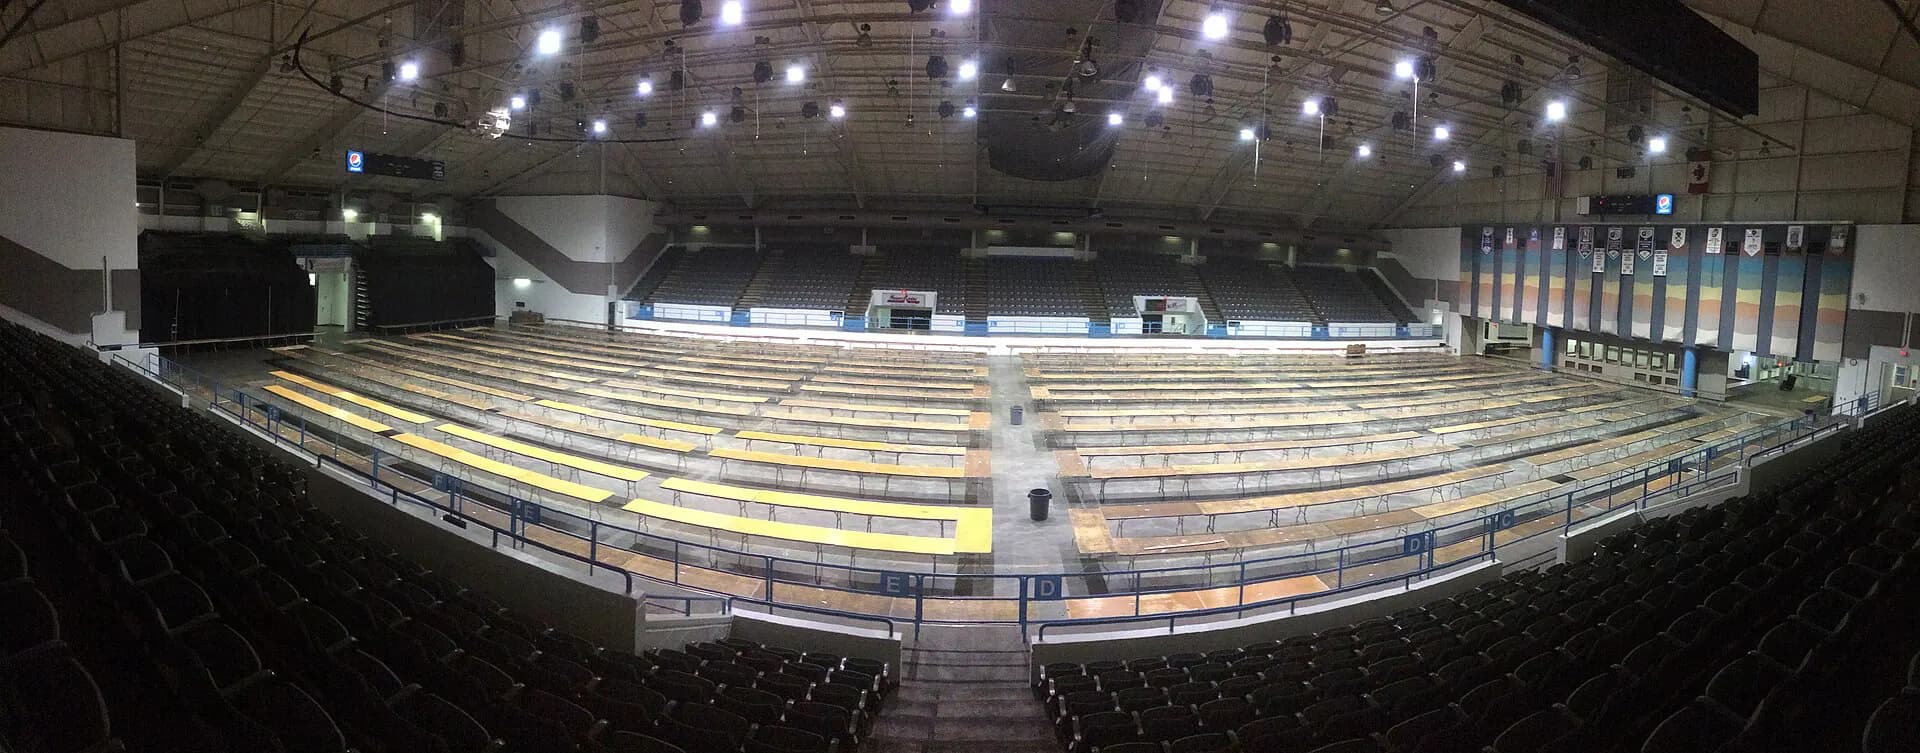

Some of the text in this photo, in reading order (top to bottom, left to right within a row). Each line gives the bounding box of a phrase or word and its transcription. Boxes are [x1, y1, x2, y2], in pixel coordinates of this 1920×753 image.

[525, 504, 533, 518] E
[1502, 513, 1512, 527] C
[1410, 538, 1420, 552] D
[887, 576, 900, 593] E
[1040, 579, 1055, 596] D
